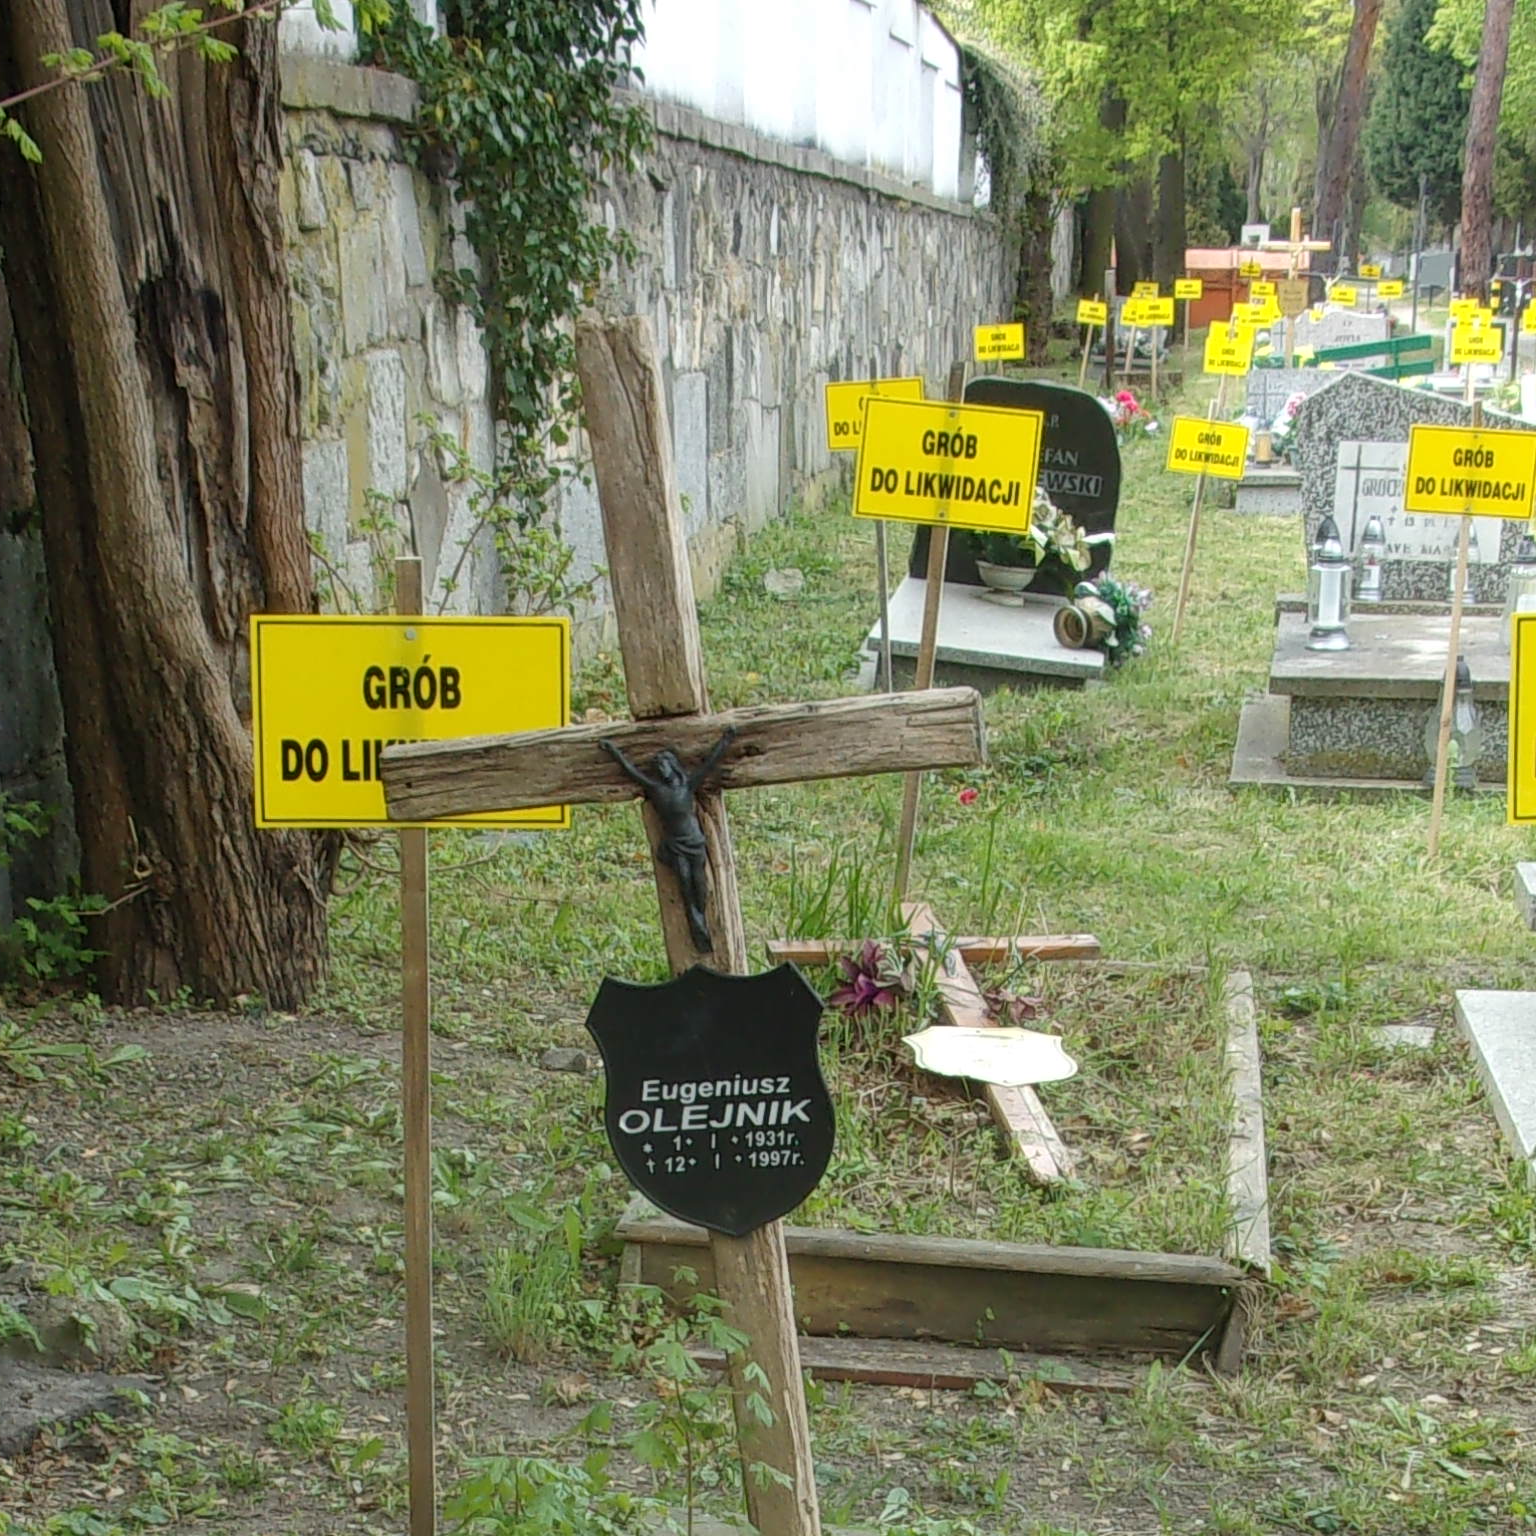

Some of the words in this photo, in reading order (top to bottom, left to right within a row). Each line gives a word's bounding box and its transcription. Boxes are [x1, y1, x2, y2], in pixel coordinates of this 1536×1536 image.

[922, 426, 978, 459] GRÓB
[1197, 430, 1222, 446] GRÓB
[1041, 447, 1079, 467] FAN
[1175, 447, 1189, 460] DO
[1189, 451, 1240, 467] LIKWIDACJI
[1453, 444, 1494, 468] GRÓB
[870, 467, 899, 493] DO
[905, 471, 1020, 506] LIKWIDACJI
[1415, 477, 1436, 496] DO
[1440, 478, 1526, 502] LIKWIDACJI
[363, 654, 462, 710] GRÓB
[281, 738, 329, 782] DO
[641, 1074, 790, 1104] Eugeniusz
[618, 1098, 812, 1135] OLEJNIK
[664, 1156, 686, 1173] 12
[747, 1150, 805, 1168] 1997r.
